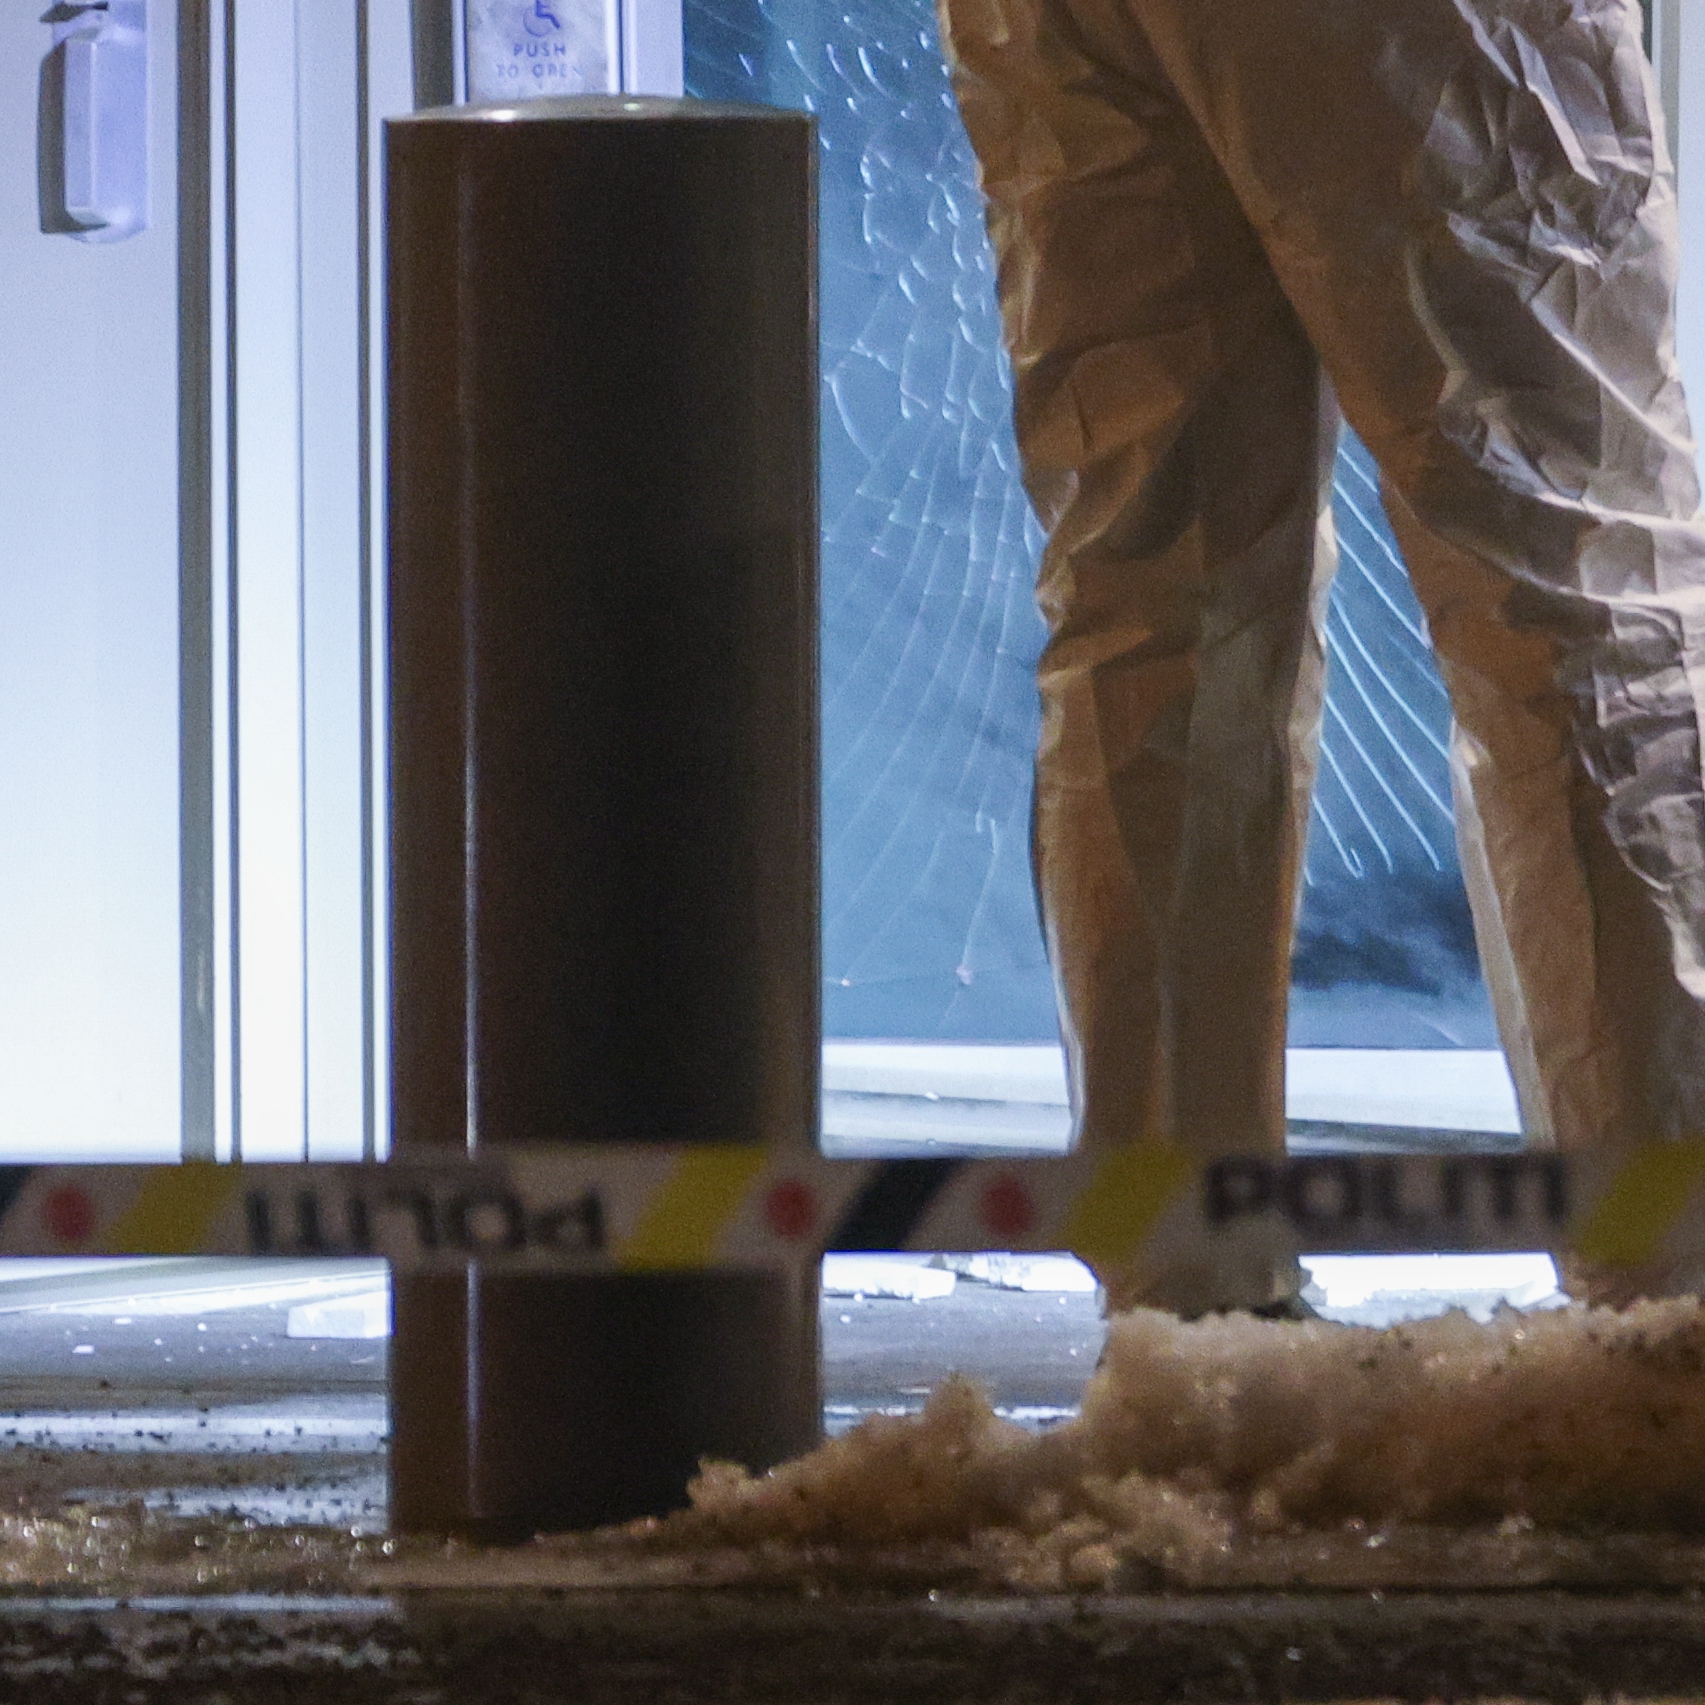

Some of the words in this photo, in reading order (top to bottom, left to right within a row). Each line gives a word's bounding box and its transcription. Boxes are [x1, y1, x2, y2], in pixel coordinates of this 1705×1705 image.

[513, 41, 566, 58] PUSH
[245, 1182, 606, 1257] POLITI
[1202, 1152, 1570, 1236] POLITI
